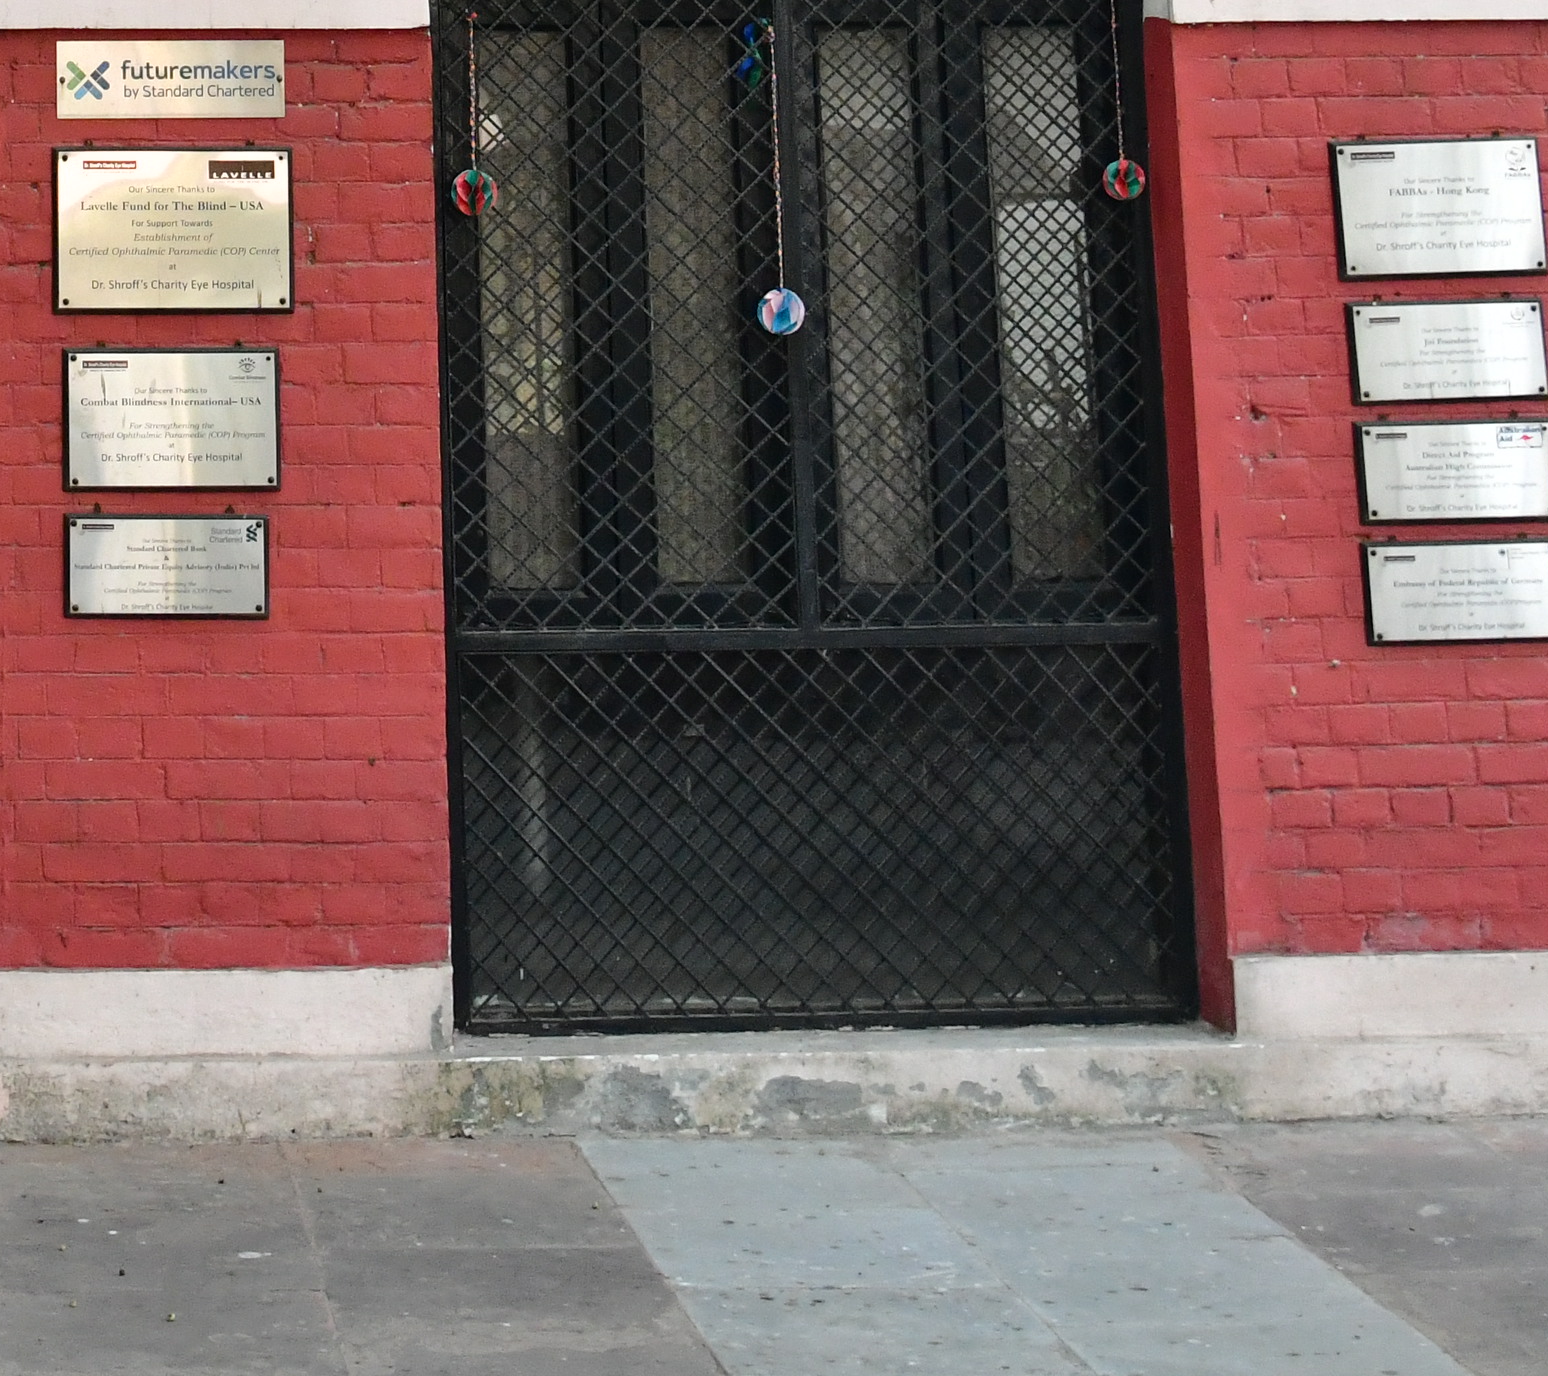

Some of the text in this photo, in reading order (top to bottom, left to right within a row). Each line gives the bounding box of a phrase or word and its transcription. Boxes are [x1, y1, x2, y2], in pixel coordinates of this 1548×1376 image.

[121, 60, 275, 79] futuremakers
[124, 84, 274, 99] by Standard Chartered
[81, 201, 263, 210] Lavelle Fund for The Blind USA
[81, 395, 117, 406] Combat
[122, 398, 167, 406] Blindness
[241, 397, 261, 405] USA
